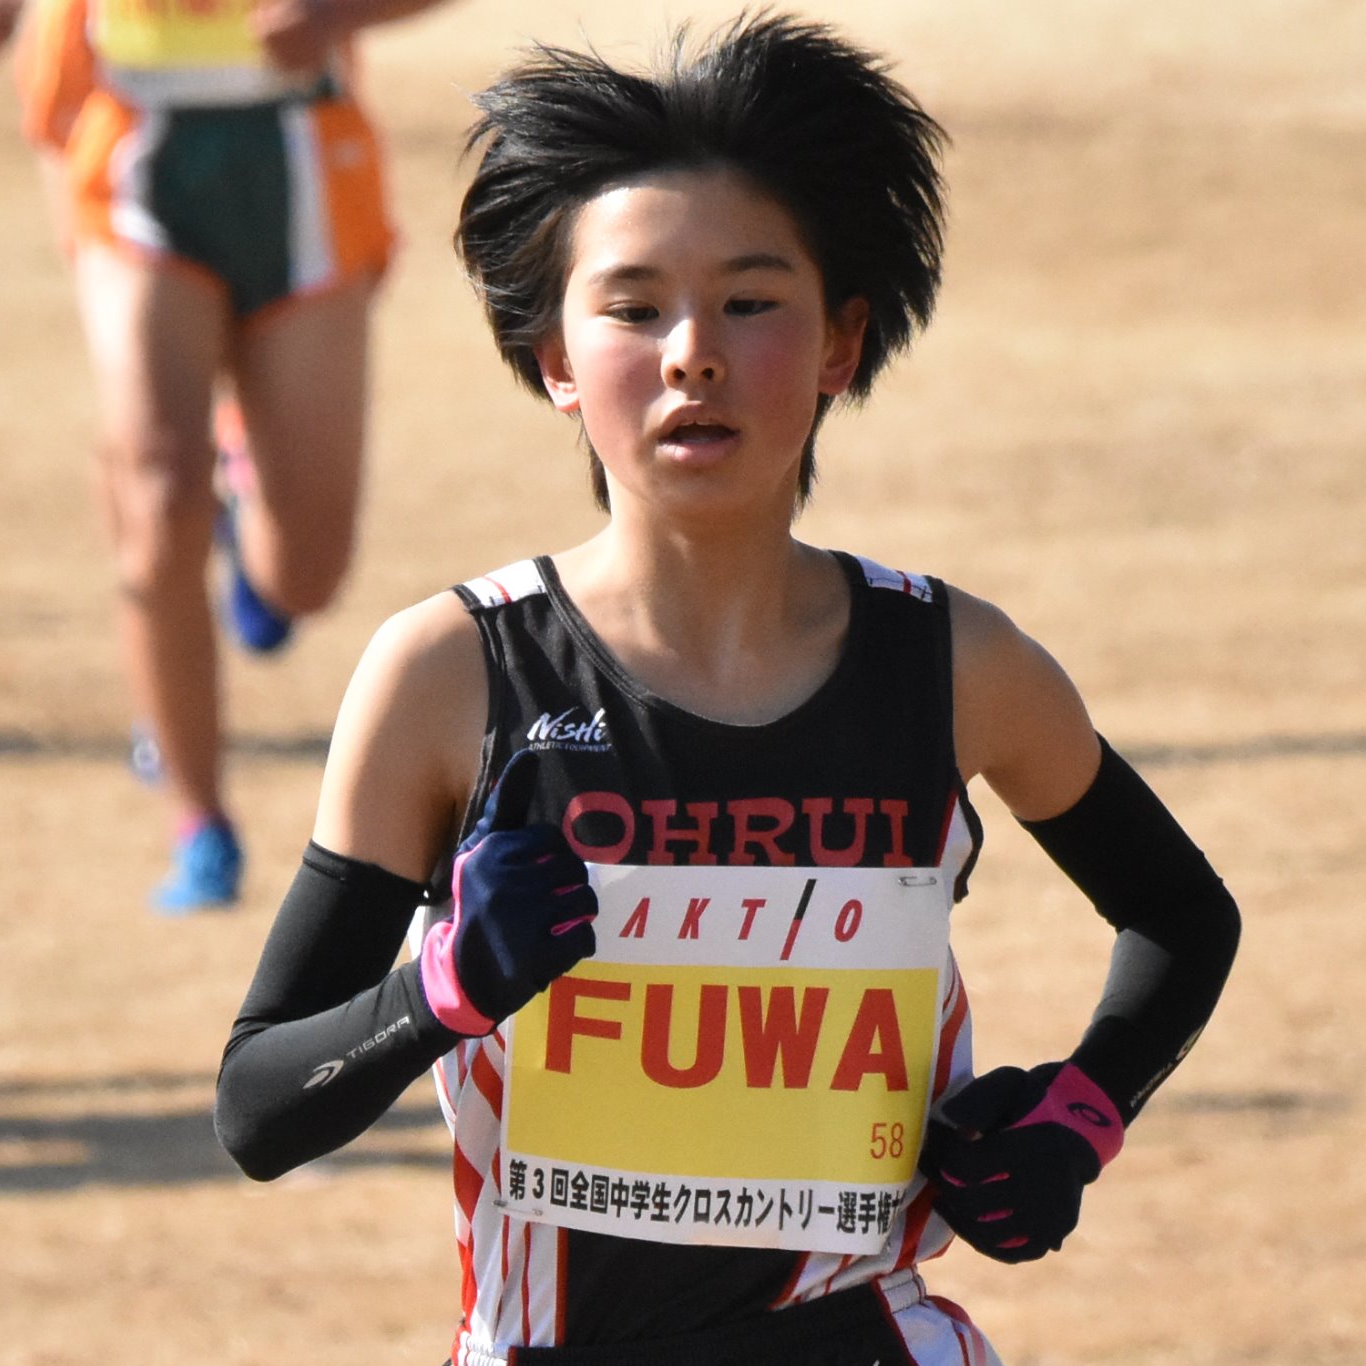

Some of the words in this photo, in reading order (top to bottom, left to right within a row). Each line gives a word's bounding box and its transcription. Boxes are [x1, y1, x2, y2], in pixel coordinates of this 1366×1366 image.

[562, 791, 913, 866] OHRUI
[346, 1015, 410, 1058] TIGORA
[545, 976, 909, 1092] FUWA
[870, 1122, 904, 1159] 58
